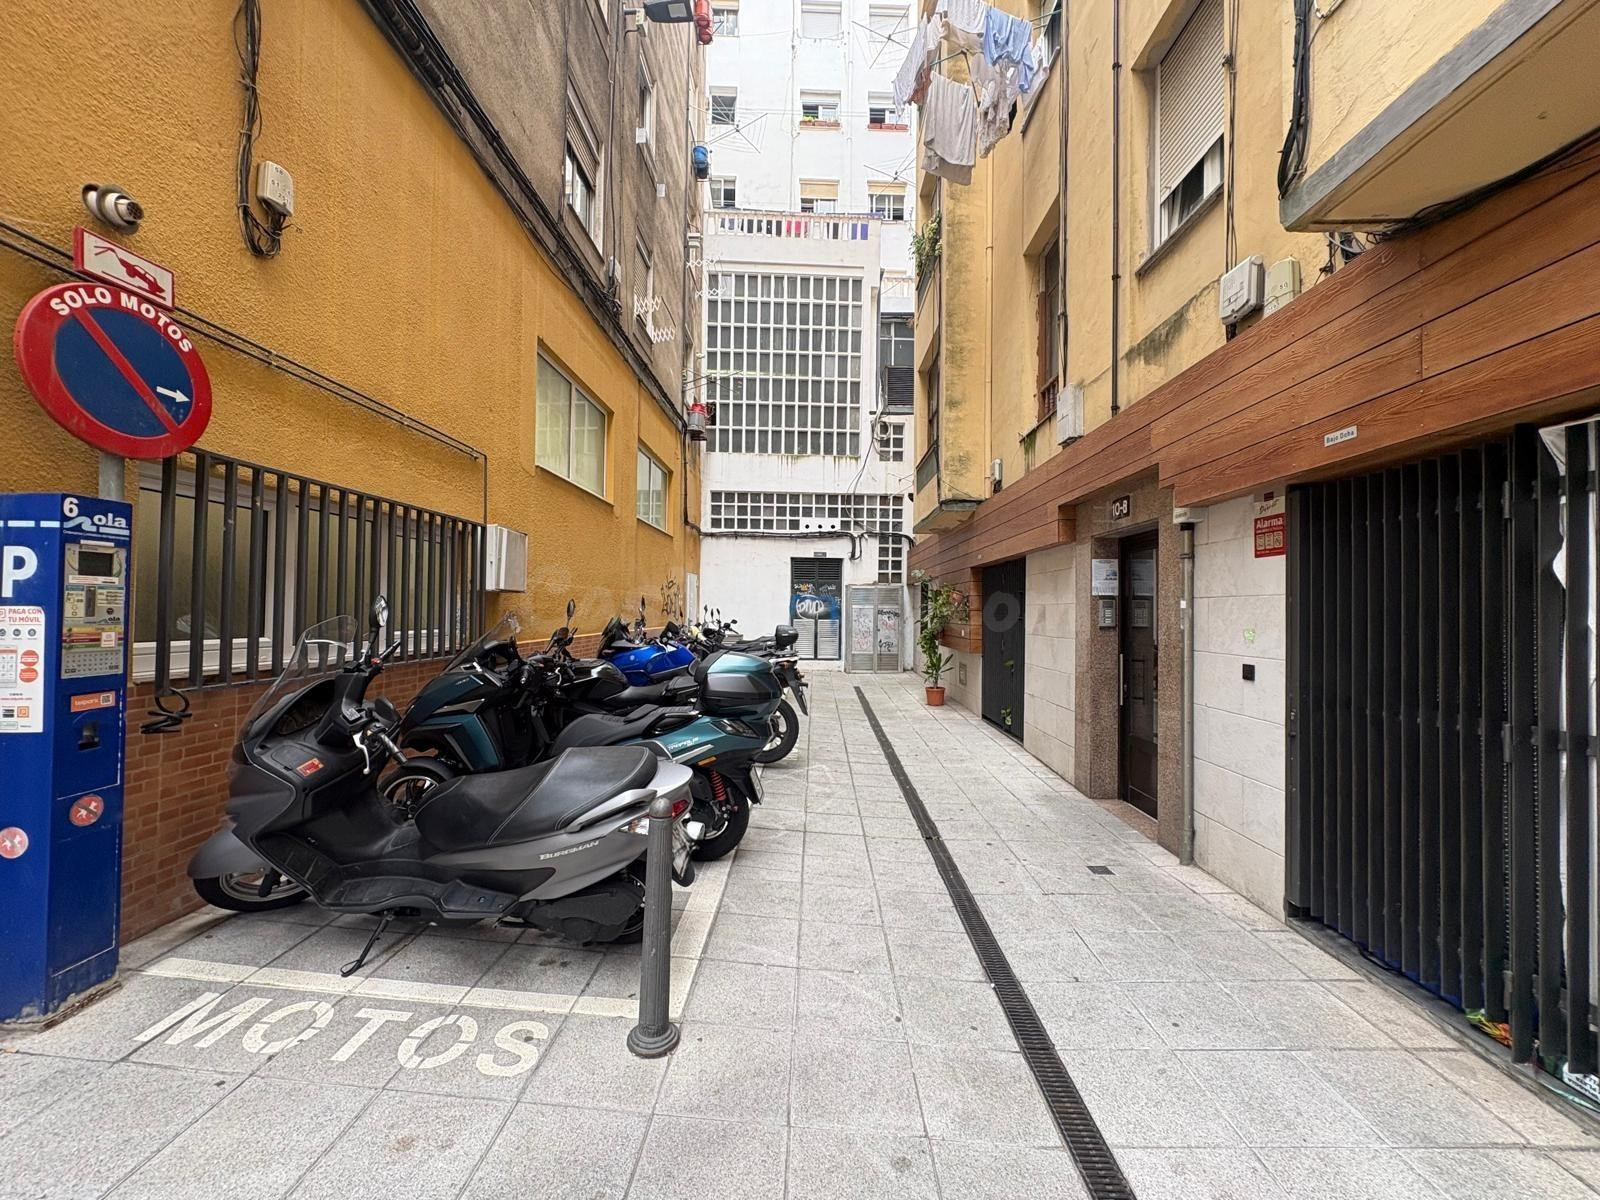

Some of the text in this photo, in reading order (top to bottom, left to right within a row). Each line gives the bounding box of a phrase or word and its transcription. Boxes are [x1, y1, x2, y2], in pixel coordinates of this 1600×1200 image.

[50, 287, 193, 353] SOLO MOTOS
[63, 497, 79, 518] 6
[93, 513, 129, 528] ola
[1256, 517, 1284, 529] Alarma
[1, 545, 38, 598] P
[132, 991, 550, 1077] MOTOS
